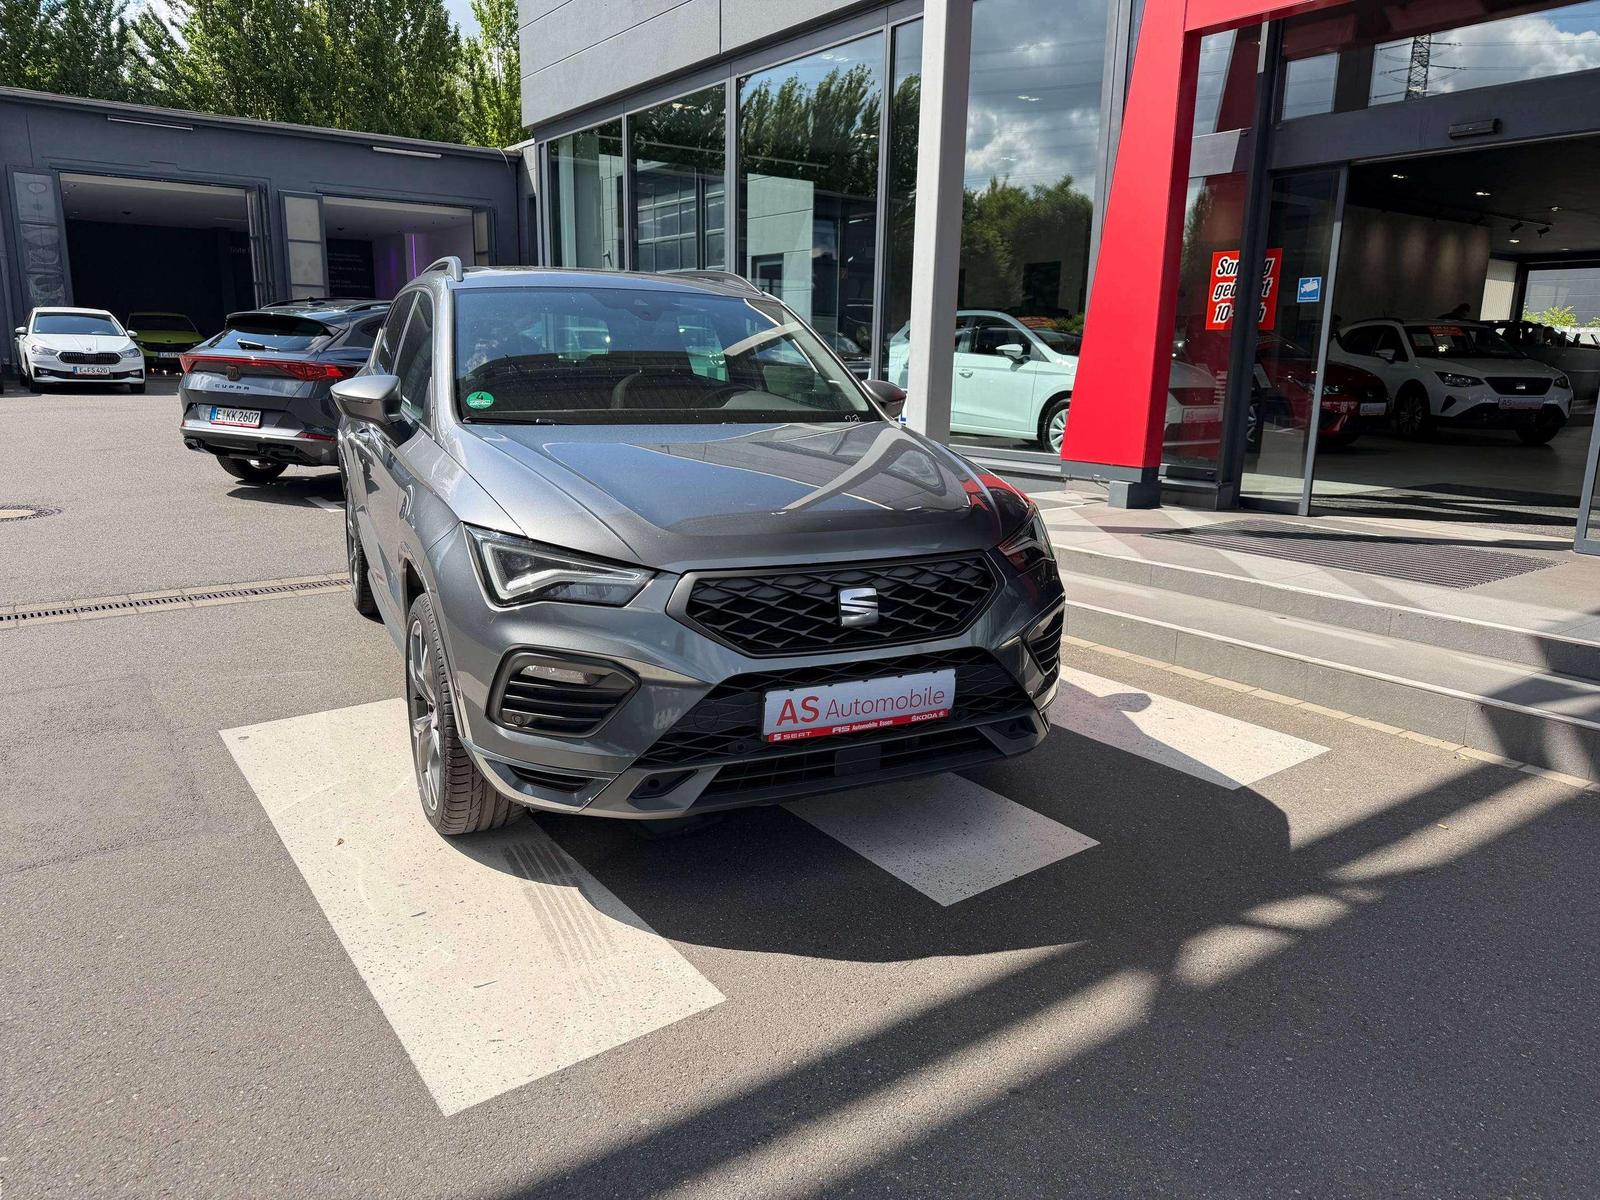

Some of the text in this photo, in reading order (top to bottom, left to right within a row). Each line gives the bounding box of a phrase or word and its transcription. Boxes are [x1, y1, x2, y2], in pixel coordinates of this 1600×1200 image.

[476, 392, 484, 400] 4
[237, 411, 260, 423] 2607
[776, 686, 945, 726] AS Automobile
[783, 731, 812, 740] SEAT
[832, 725, 851, 734] AS
[911, 712, 938, 722] ŠKODA
